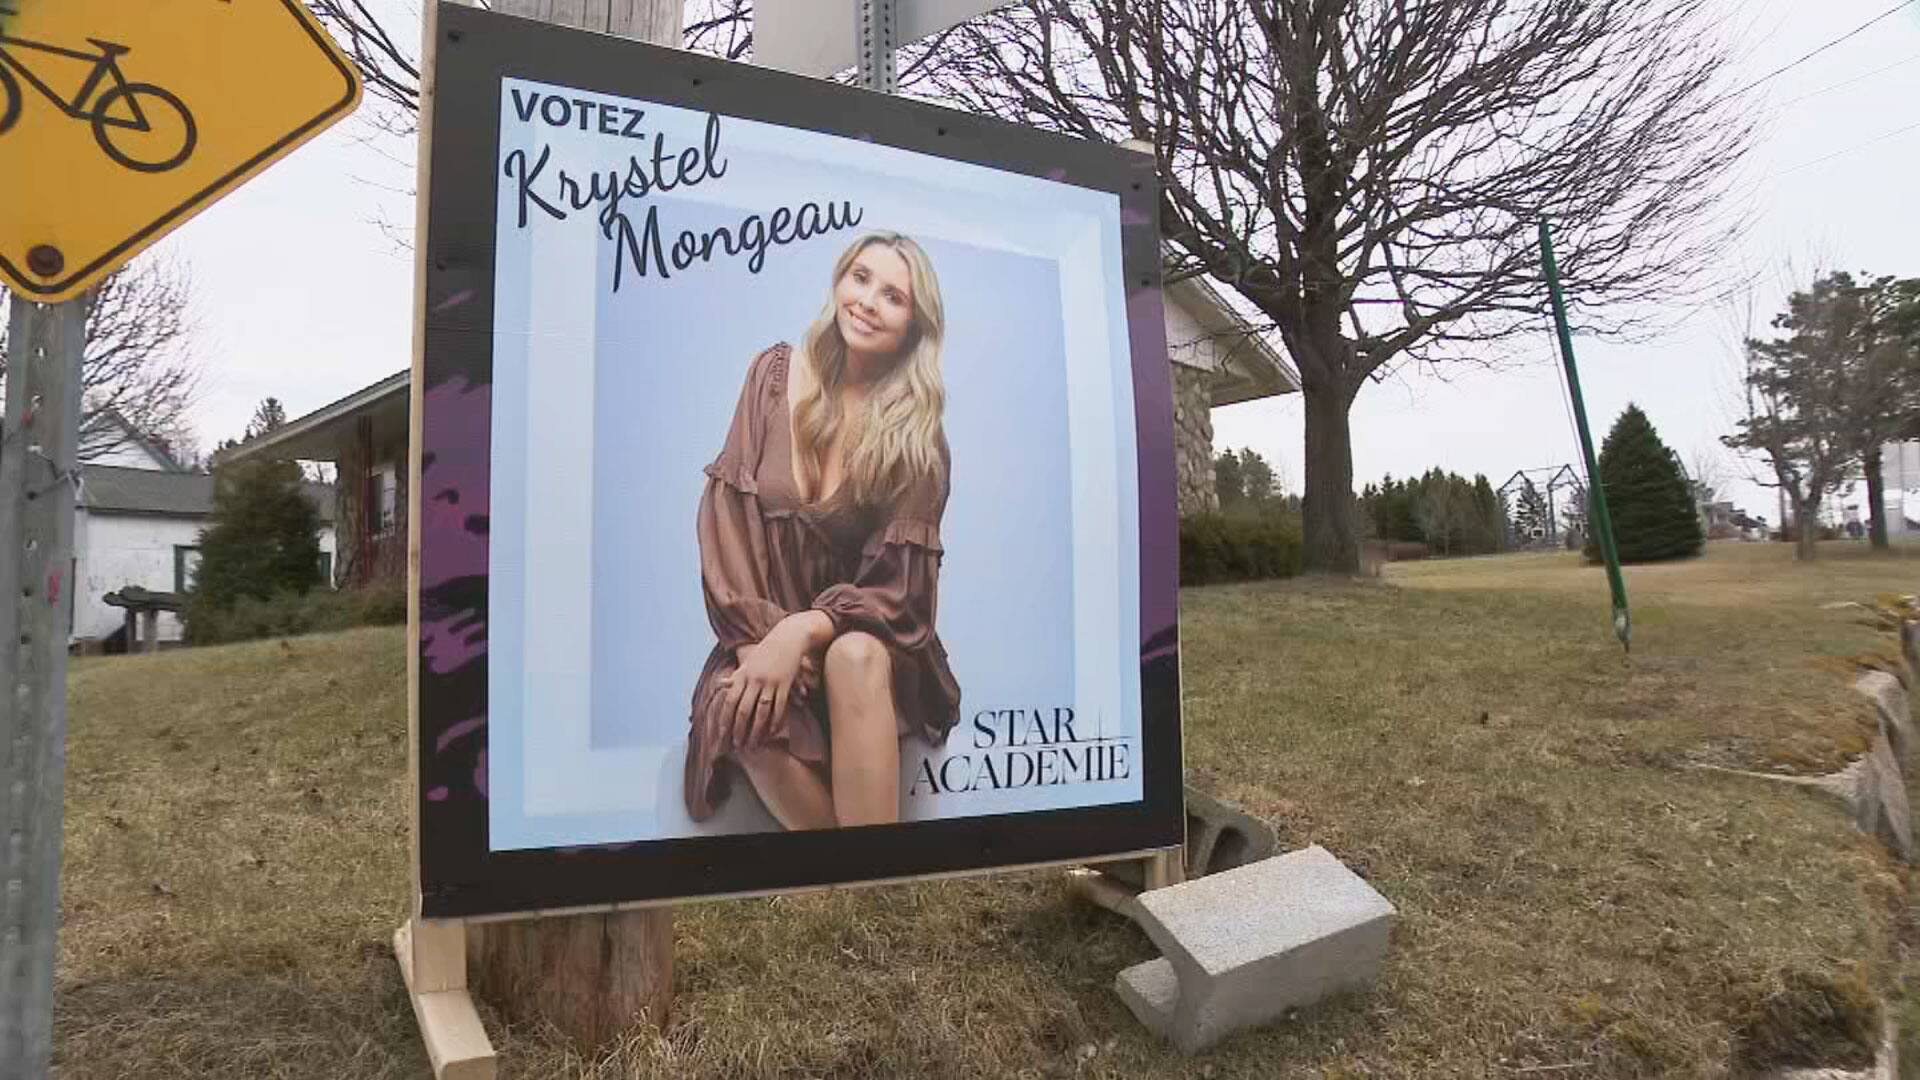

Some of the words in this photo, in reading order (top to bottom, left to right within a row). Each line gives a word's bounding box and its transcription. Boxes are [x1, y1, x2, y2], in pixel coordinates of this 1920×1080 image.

[511, 89, 645, 139] VOTEZ
[504, 112, 727, 228] Krystel
[602, 200, 863, 292] Mongeau
[973, 707, 1078, 749] STAR
